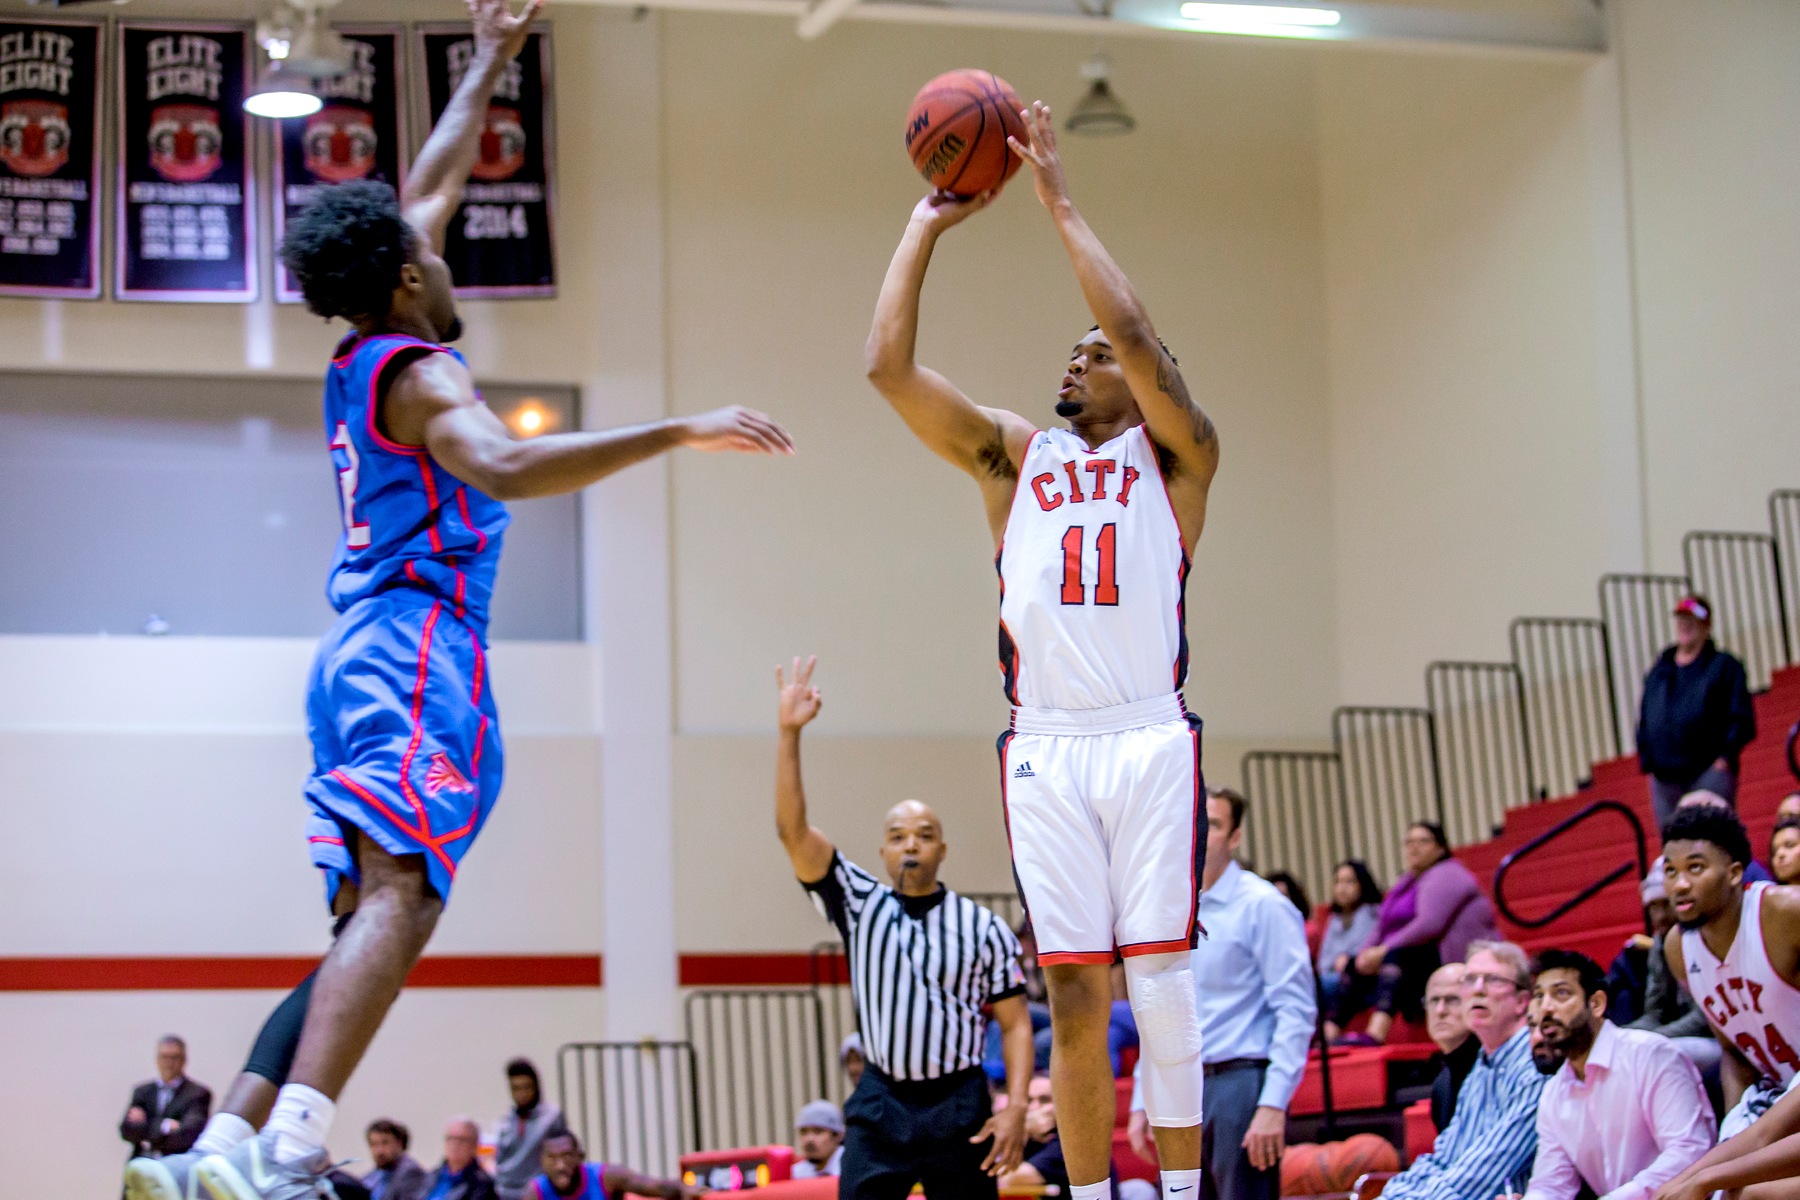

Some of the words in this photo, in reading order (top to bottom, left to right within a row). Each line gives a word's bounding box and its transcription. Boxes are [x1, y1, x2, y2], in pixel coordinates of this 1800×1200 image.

[0, 31, 73, 65] ELITE
[147, 35, 223, 71] ELITE
[0, 61, 73, 96] EIGHT
[147, 65, 223, 101] EIGHT
[463, 204, 529, 239] 2014
[1031, 459, 1140, 512] CITY
[1060, 522, 1119, 606] 11
[1703, 977, 1764, 1027] CITY
